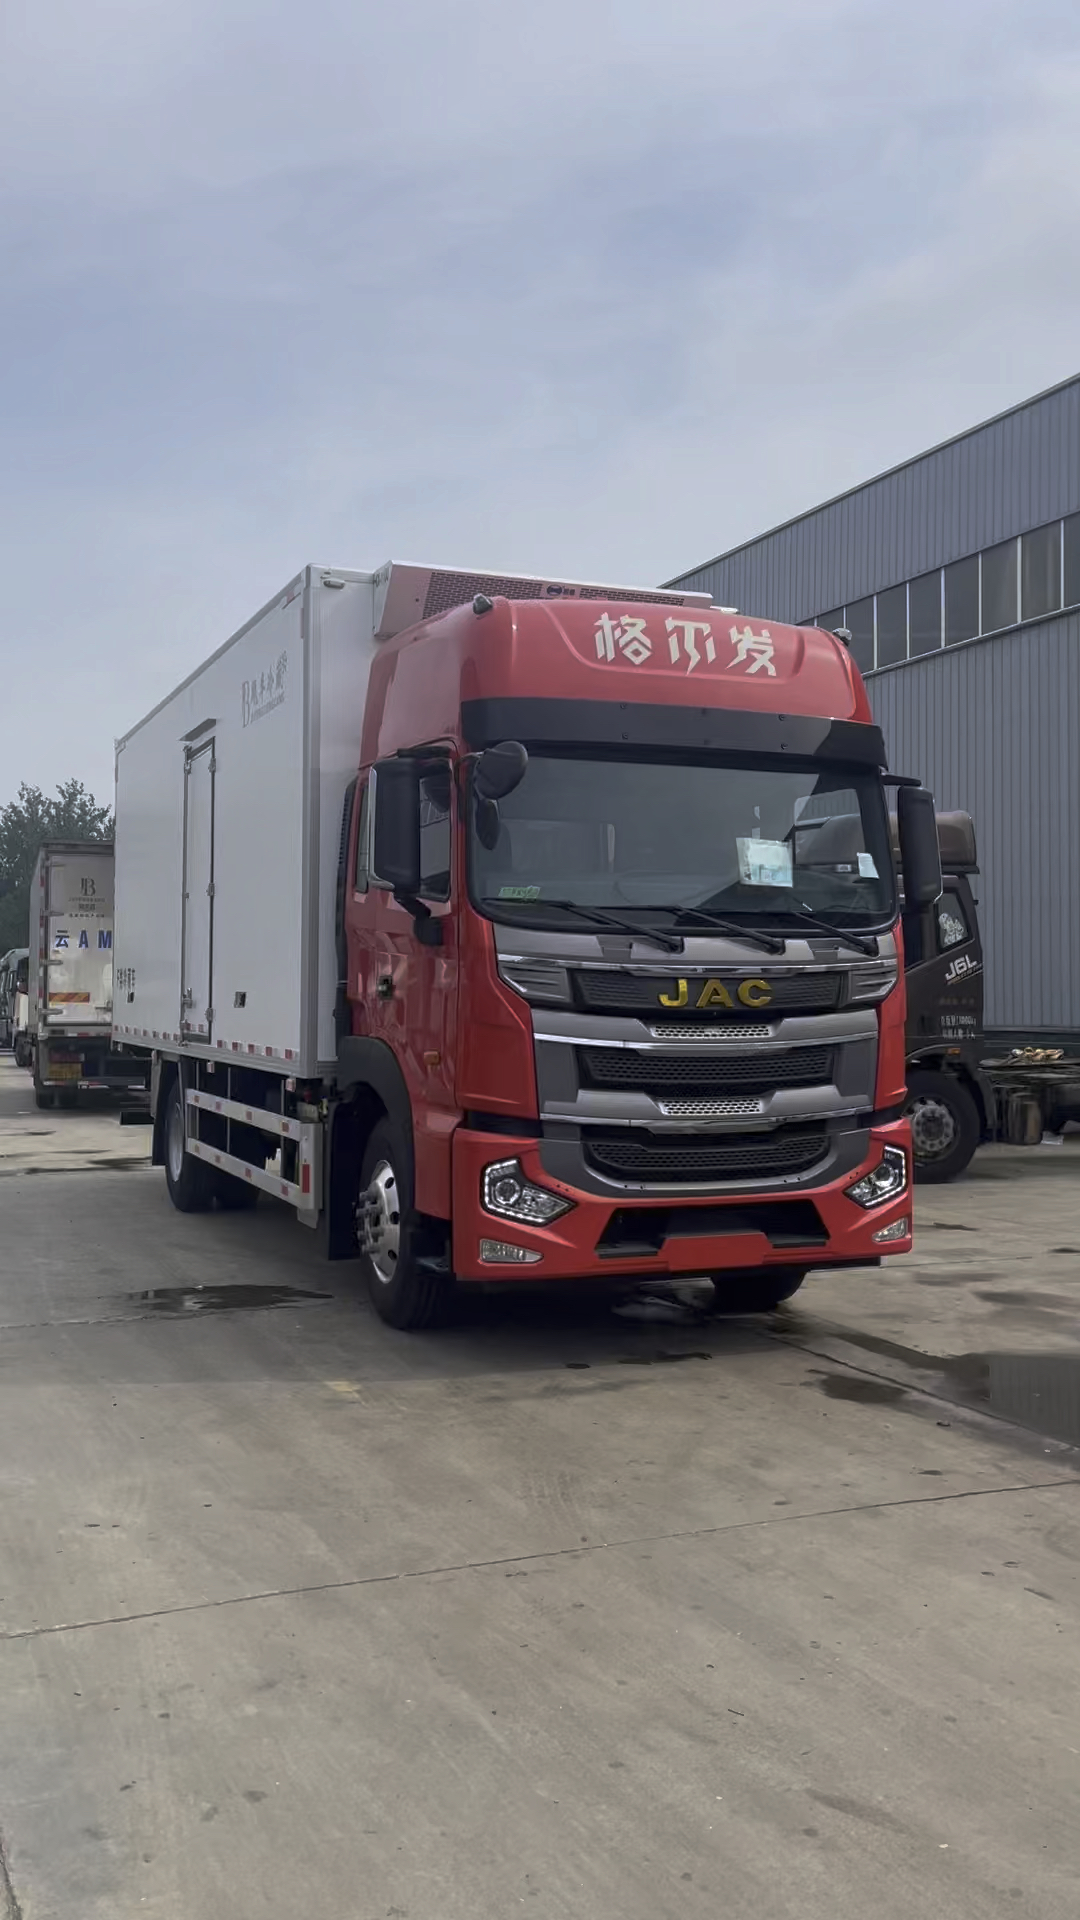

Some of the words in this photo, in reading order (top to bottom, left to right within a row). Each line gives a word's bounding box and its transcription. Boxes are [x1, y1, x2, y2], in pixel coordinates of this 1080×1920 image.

[594, 611, 777, 677] 格尔发
[944, 954, 978, 981] J6L
[658, 979, 773, 1008] JAC
